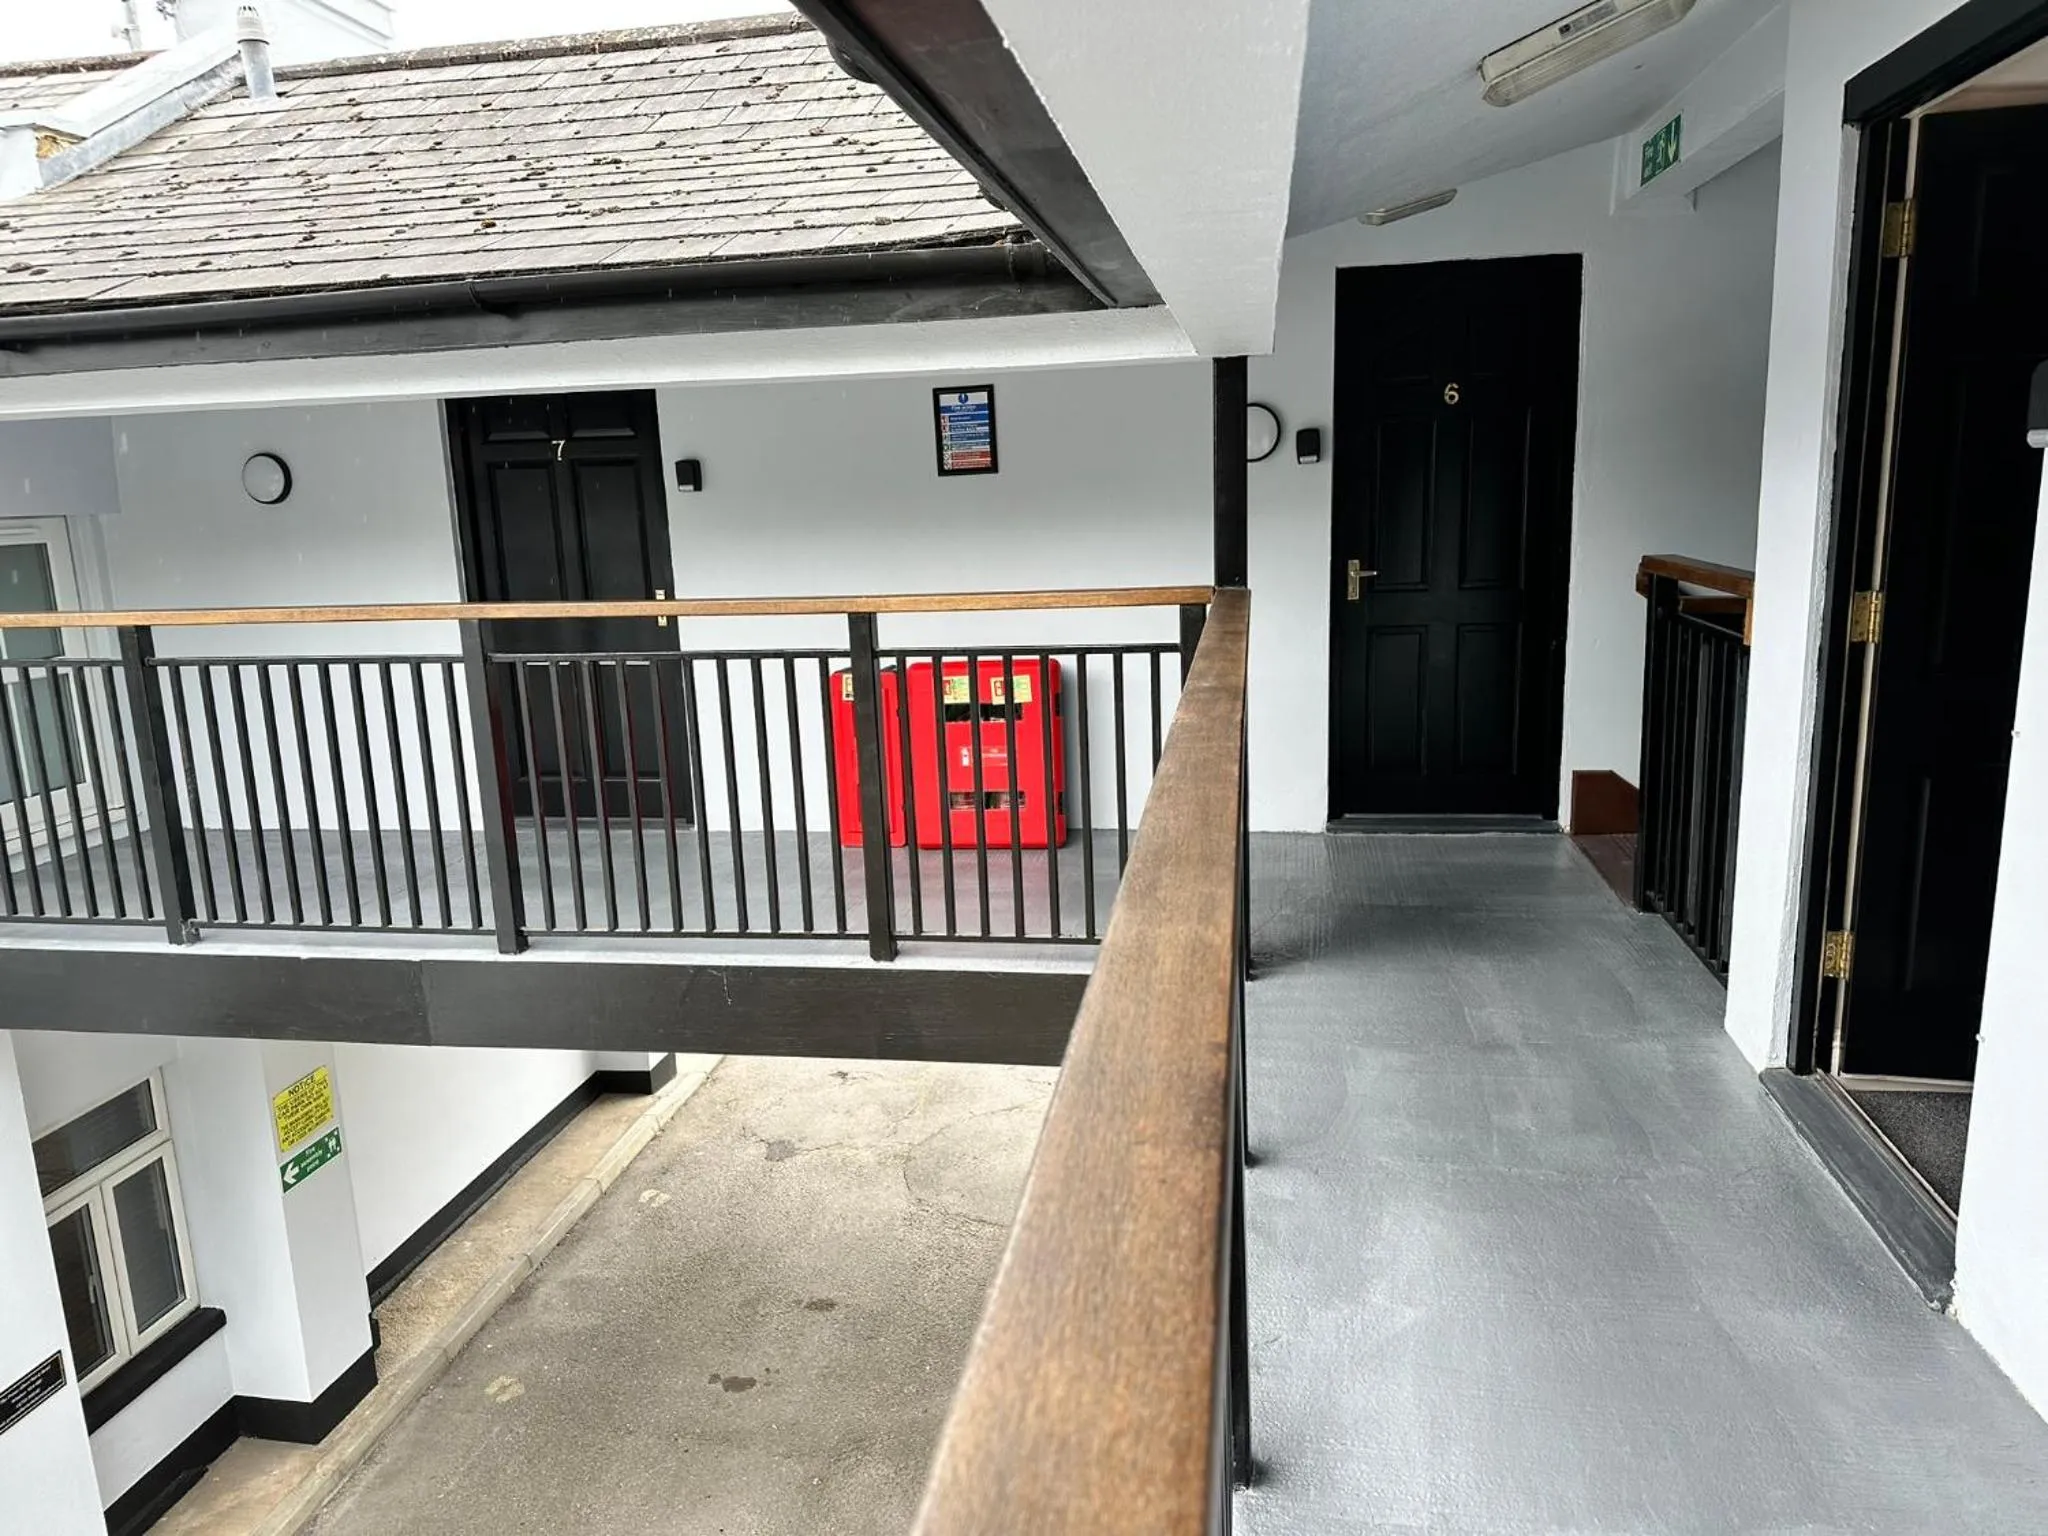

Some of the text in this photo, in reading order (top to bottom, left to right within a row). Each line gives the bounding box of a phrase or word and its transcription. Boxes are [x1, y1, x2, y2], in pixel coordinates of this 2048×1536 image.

[1444, 383, 1459, 405] 6
[552, 440, 566, 461] 7
[288, 1074, 315, 1096] NOTICE
